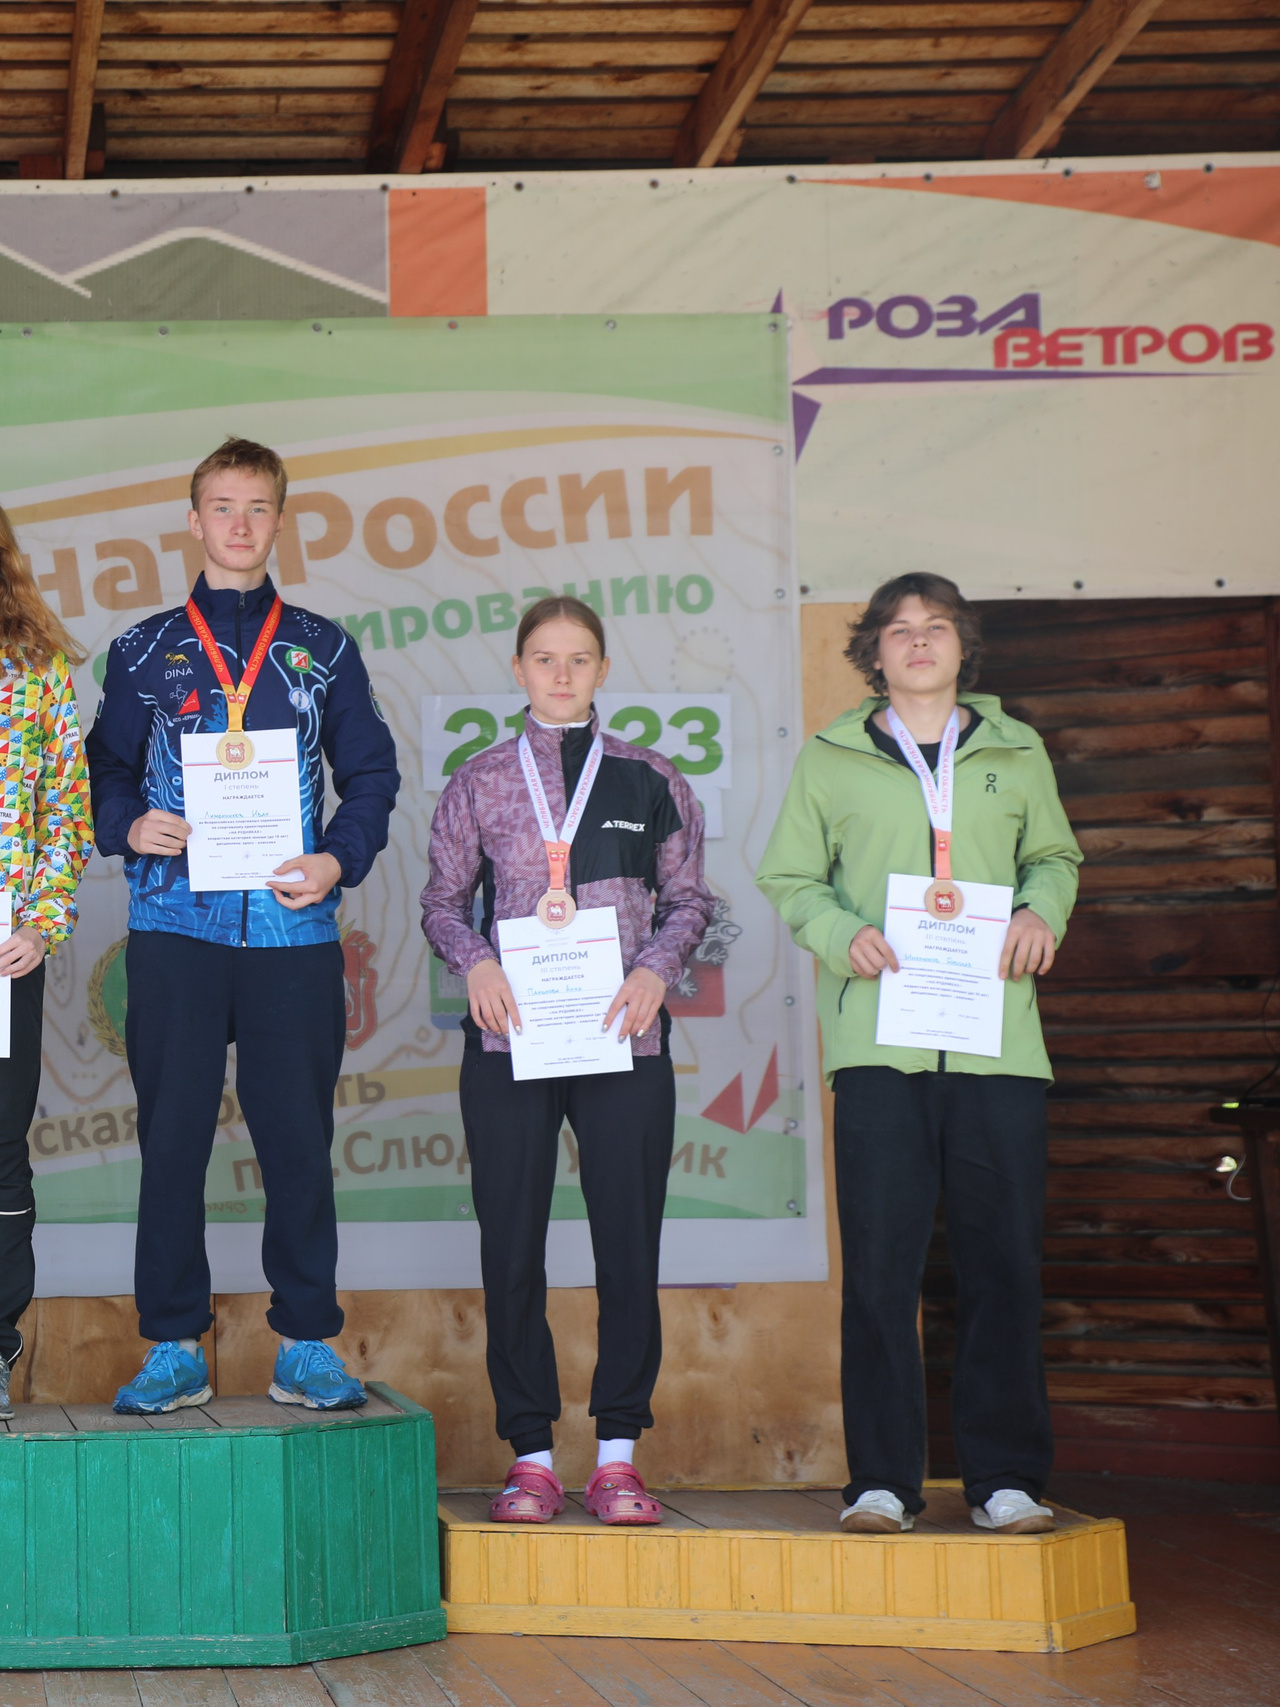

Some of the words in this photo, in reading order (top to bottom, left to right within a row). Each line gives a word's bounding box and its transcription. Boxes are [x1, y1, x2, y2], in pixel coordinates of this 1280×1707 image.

[827, 292, 1042, 340] РОЗА
[992, 322, 1276, 369] ВЕТРОВ
[249, 640, 267, 672] ОБЛАСТЬ
[164, 667, 194, 680] DINA
[213, 770, 269, 783] ДИПЛОМ
[612, 820, 646, 832] TERREX
[917, 919, 976, 936] ДИПЛОМ
[531, 950, 589, 966] ДИПЛОМ
[549, 965, 582, 974] степень
[541, 974, 585, 983] НАГРАЖДАЕТСЯ
